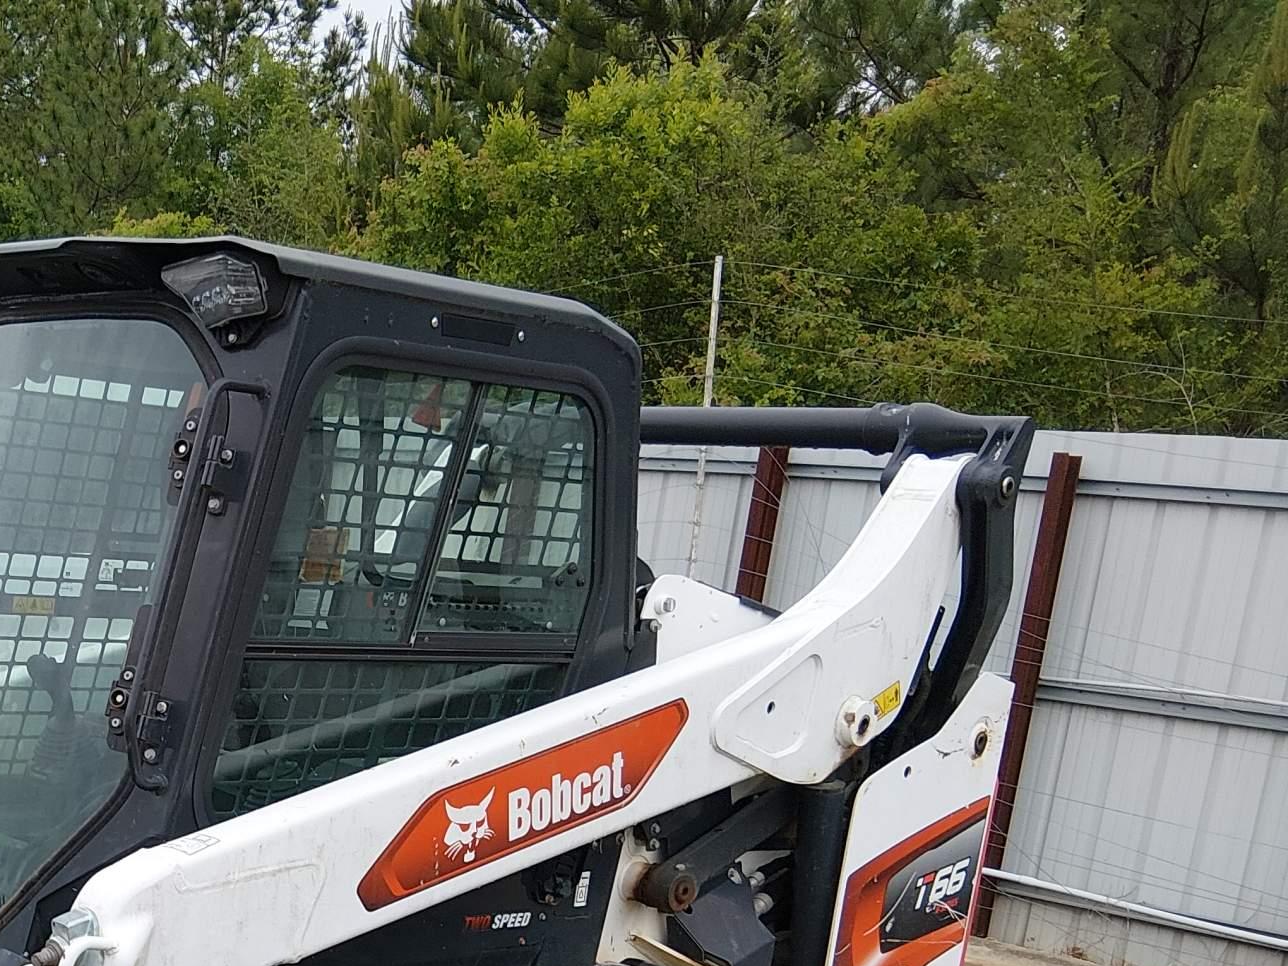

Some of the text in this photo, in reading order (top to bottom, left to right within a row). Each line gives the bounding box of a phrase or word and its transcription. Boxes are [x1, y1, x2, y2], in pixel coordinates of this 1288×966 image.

[508, 751, 624, 842] Bobcat
[915, 857, 970, 910] T66
[464, 912, 532, 929] TWO SPEED
